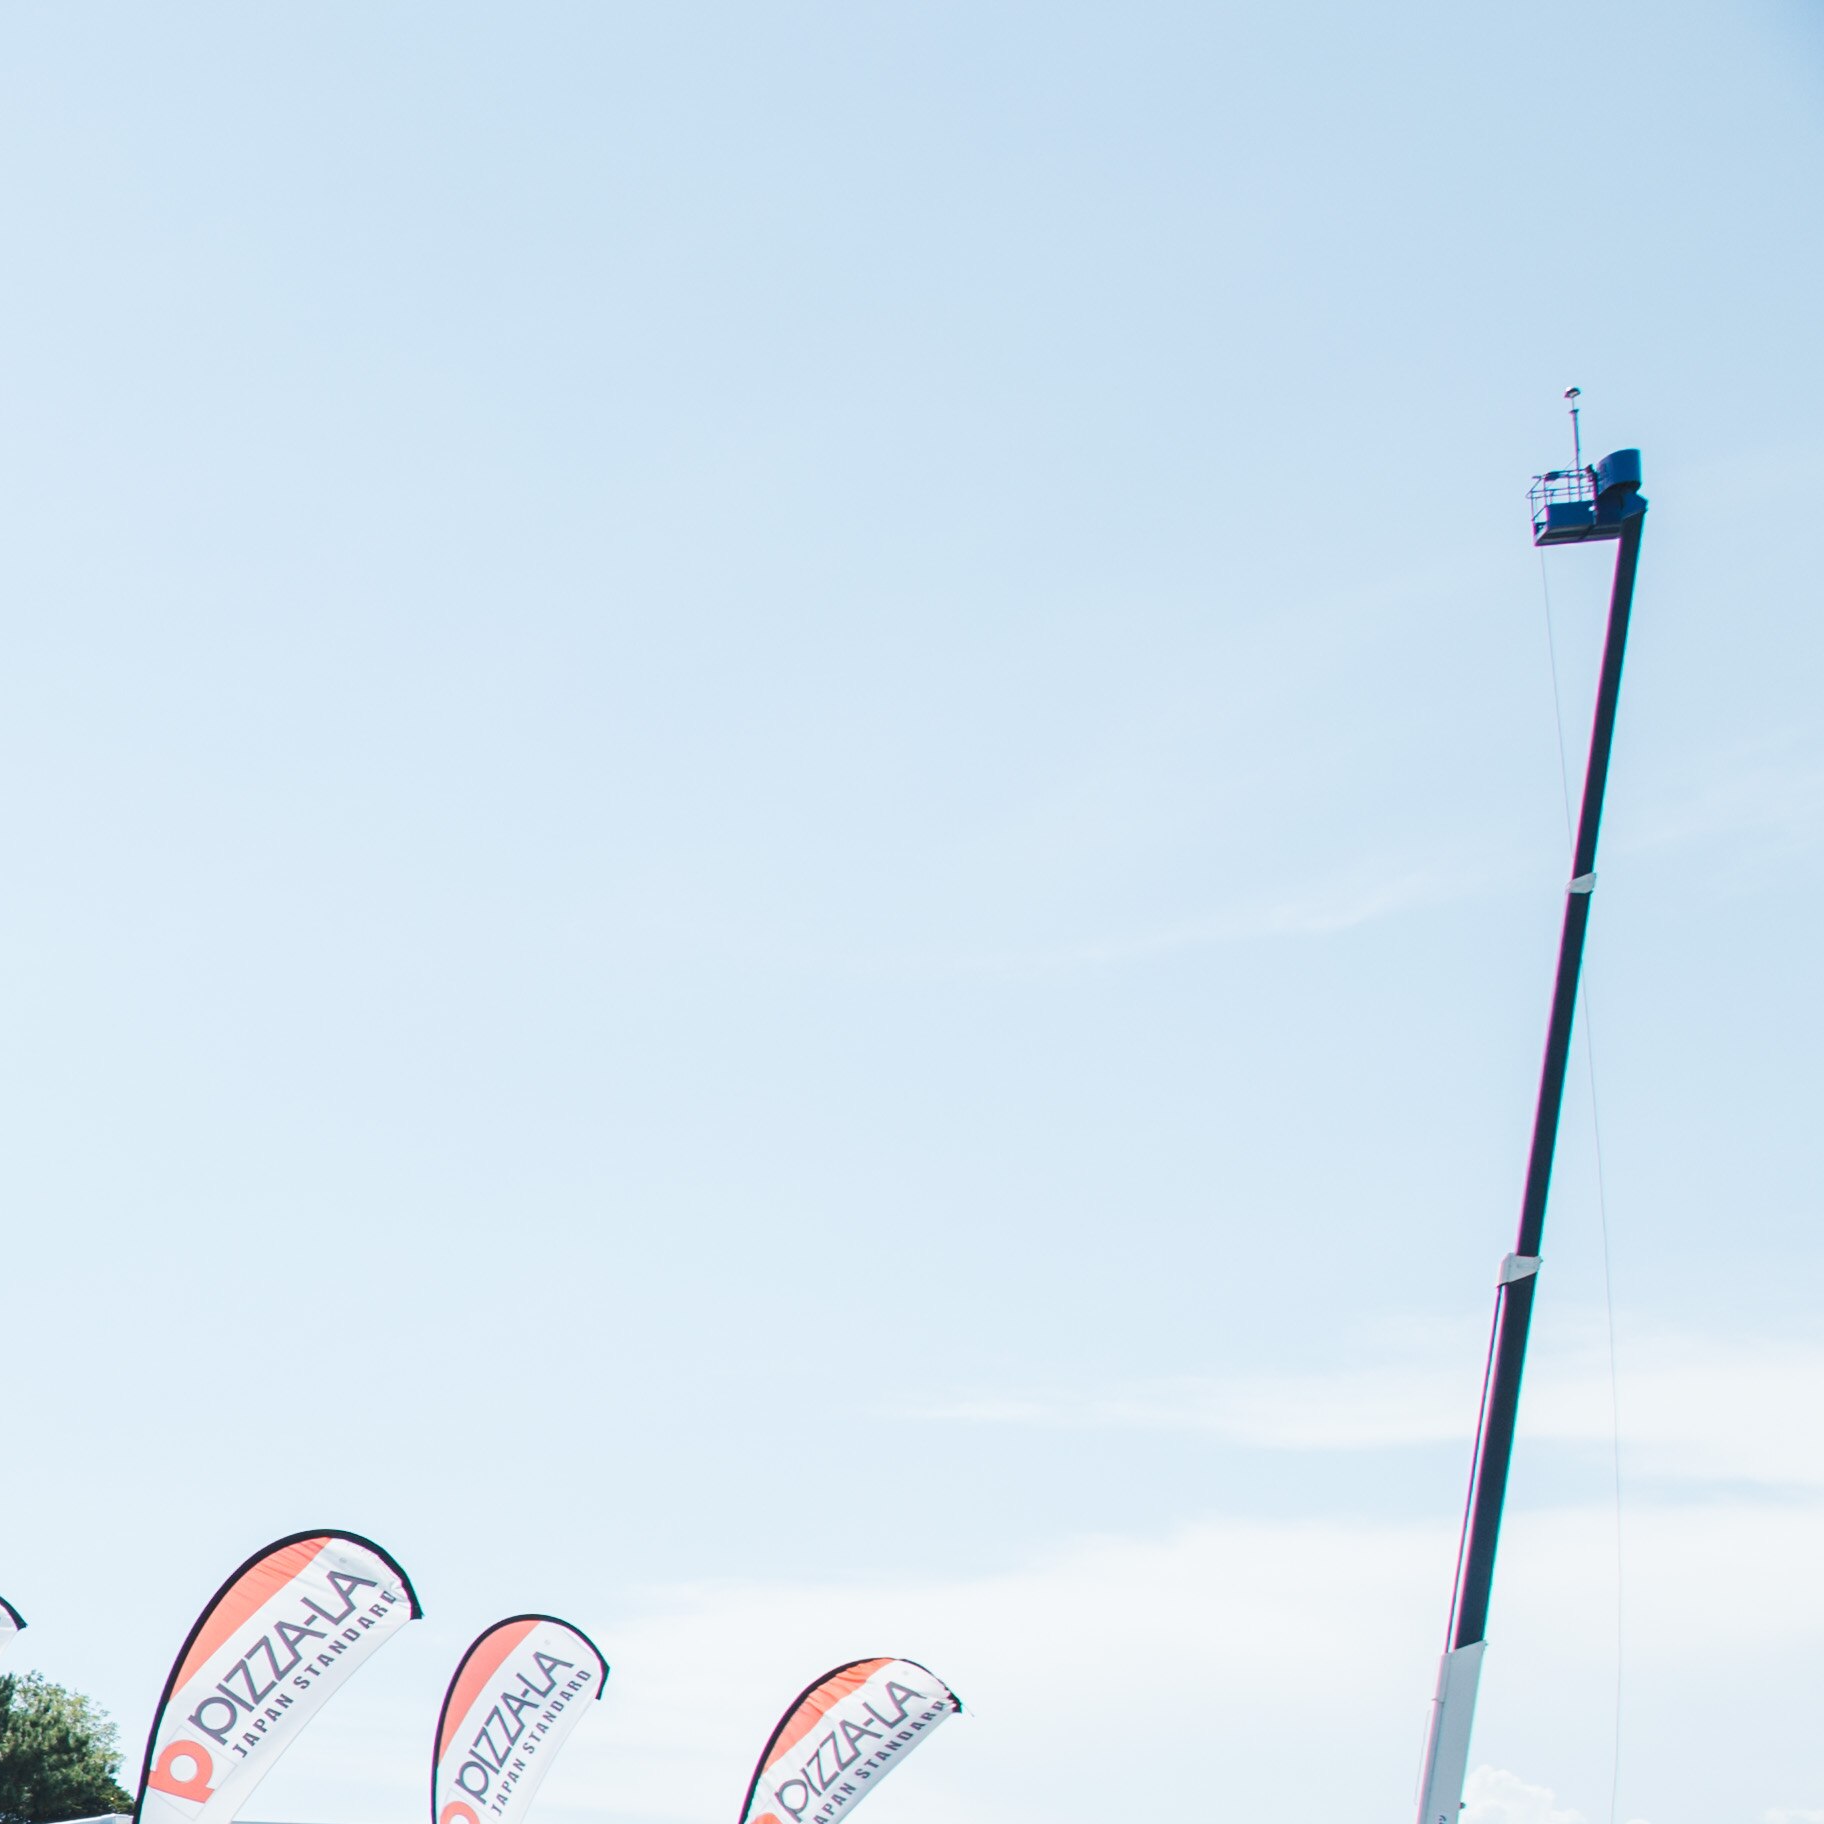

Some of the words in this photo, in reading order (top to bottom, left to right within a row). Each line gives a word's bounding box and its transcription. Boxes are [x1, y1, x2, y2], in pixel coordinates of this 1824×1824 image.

[232, 1693, 294, 1758] JAPAN
[293, 1590, 397, 1690] STANDARD
[490, 1757, 527, 1817] JAPAN
[522, 1668, 593, 1755] STANDARD
[854, 1699, 947, 1779] STANDARD
